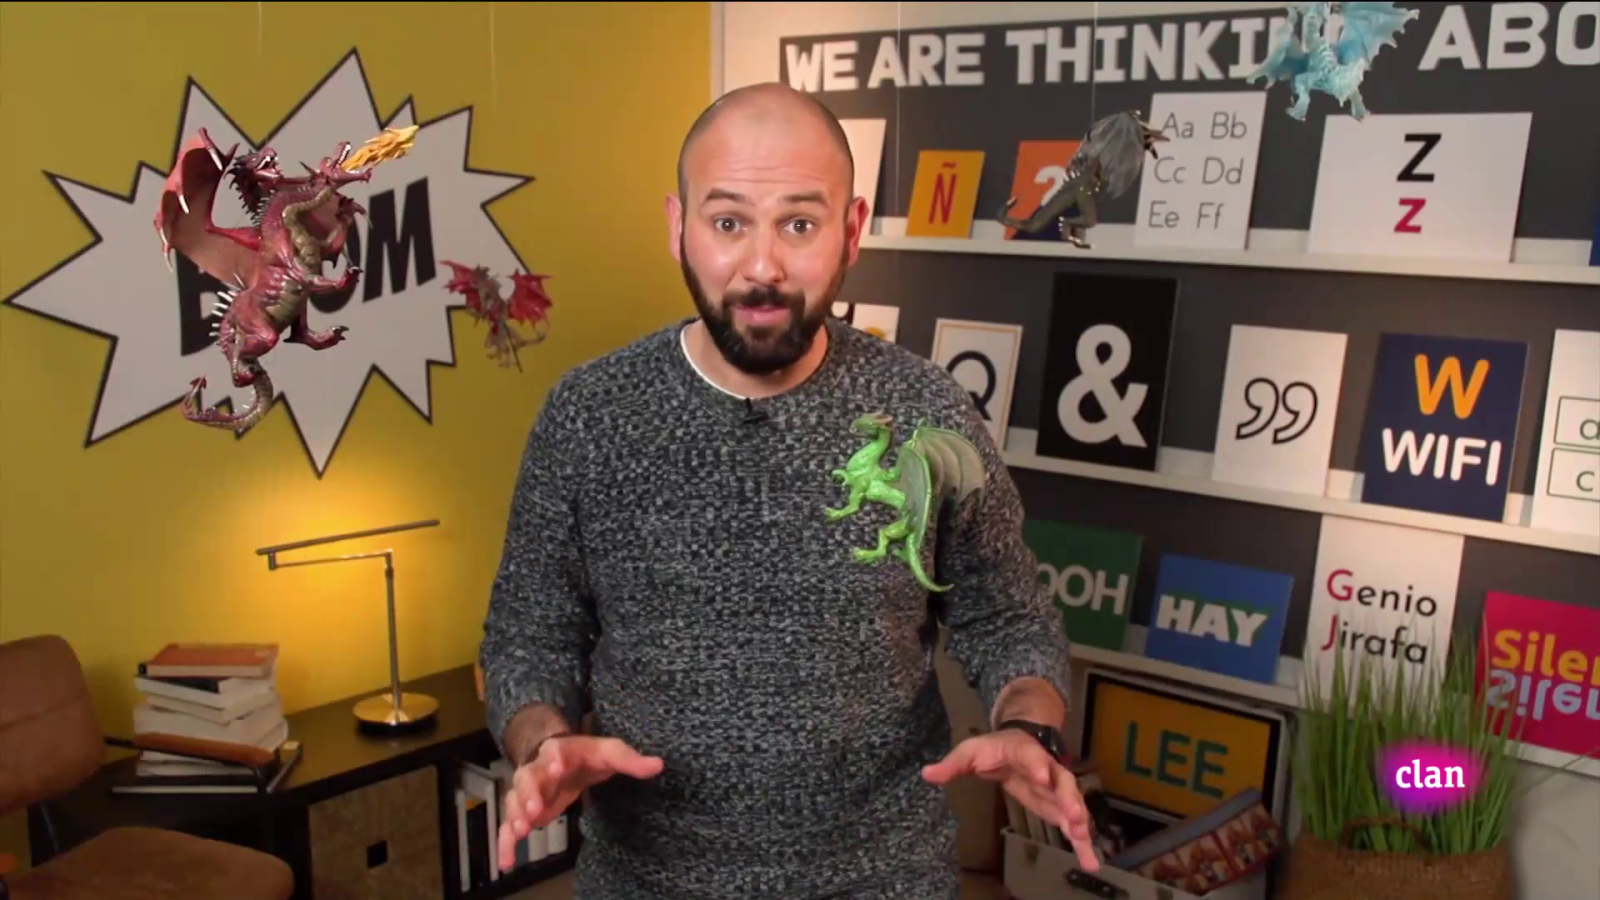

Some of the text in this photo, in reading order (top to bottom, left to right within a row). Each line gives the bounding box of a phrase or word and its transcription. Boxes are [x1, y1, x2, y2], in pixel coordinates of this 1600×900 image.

[785, 40, 860, 92] WE
[867, 33, 985, 88] ARE
[1418, 3, 1600, 71] ABO
[1161, 111, 1248, 140] Aa Bb
[1153, 156, 1245, 186] Cc Dd
[1396, 133, 1442, 183] Z
[928, 162, 957, 225] Ñ
[1148, 201, 1226, 230] Ee Ff
[946, 350, 992, 422] Q
[1057, 324, 1149, 448] &
[1414, 353, 1490, 419] W
[1381, 428, 1501, 486] WIFI
[1326, 568, 1437, 617] Genio
[1155, 594, 1267, 647] HAY
[1320, 614, 1428, 664] Jirafa
[1123, 720, 1228, 799] LEE
